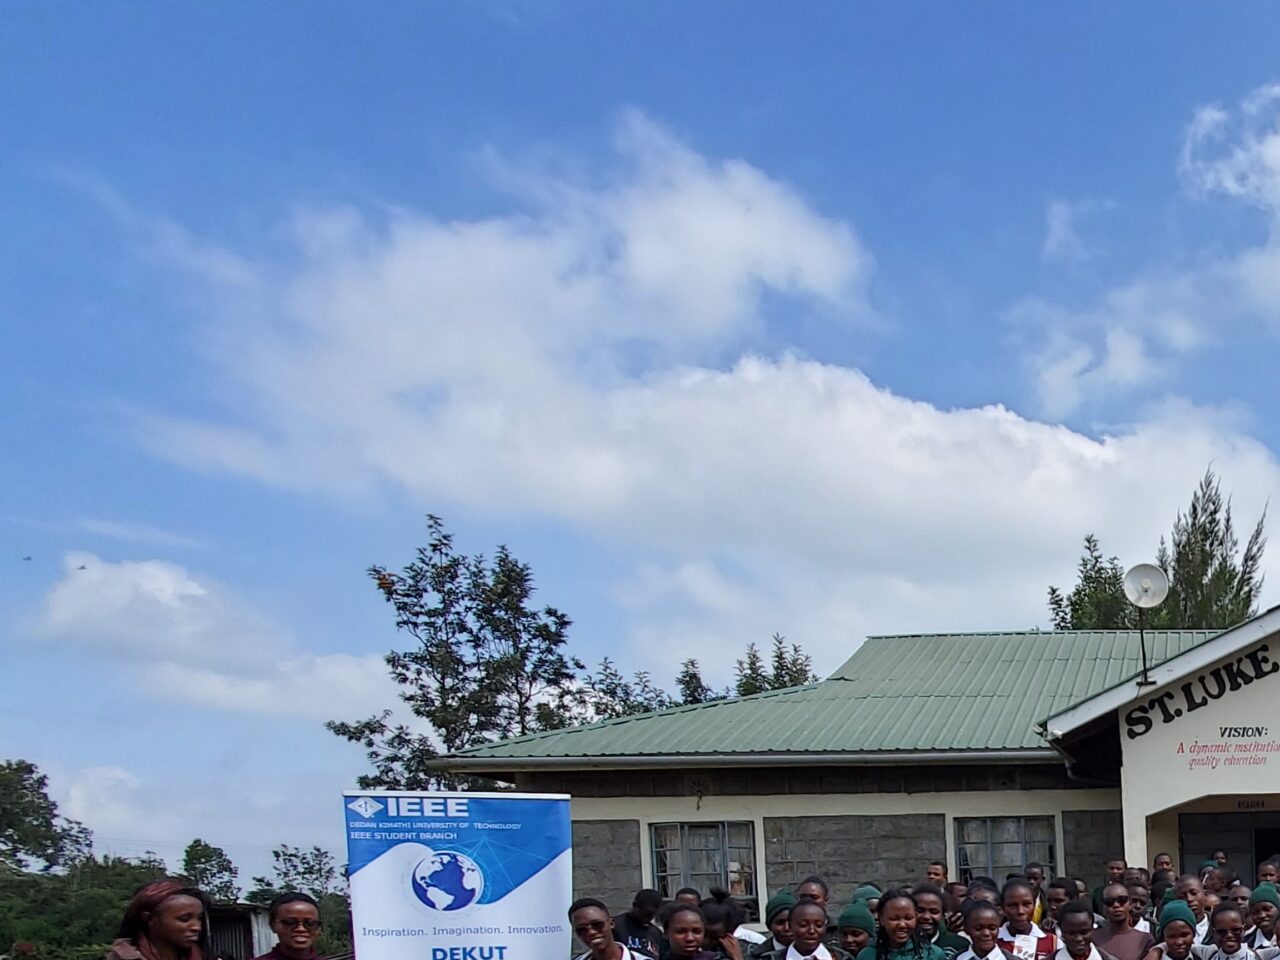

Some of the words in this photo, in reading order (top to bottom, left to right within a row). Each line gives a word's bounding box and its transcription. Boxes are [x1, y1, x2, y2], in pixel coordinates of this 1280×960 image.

[1219, 727, 1269, 738] VISION:
[1177, 742, 1184, 754] A
[387, 797, 470, 817] IEEE
[374, 832, 417, 840] STUDENT
[420, 832, 457, 840] BRANCH
[362, 927, 428, 938] Inspiration.
[432, 926, 504, 938] Imagination.
[508, 925, 565, 935] Innovation.
